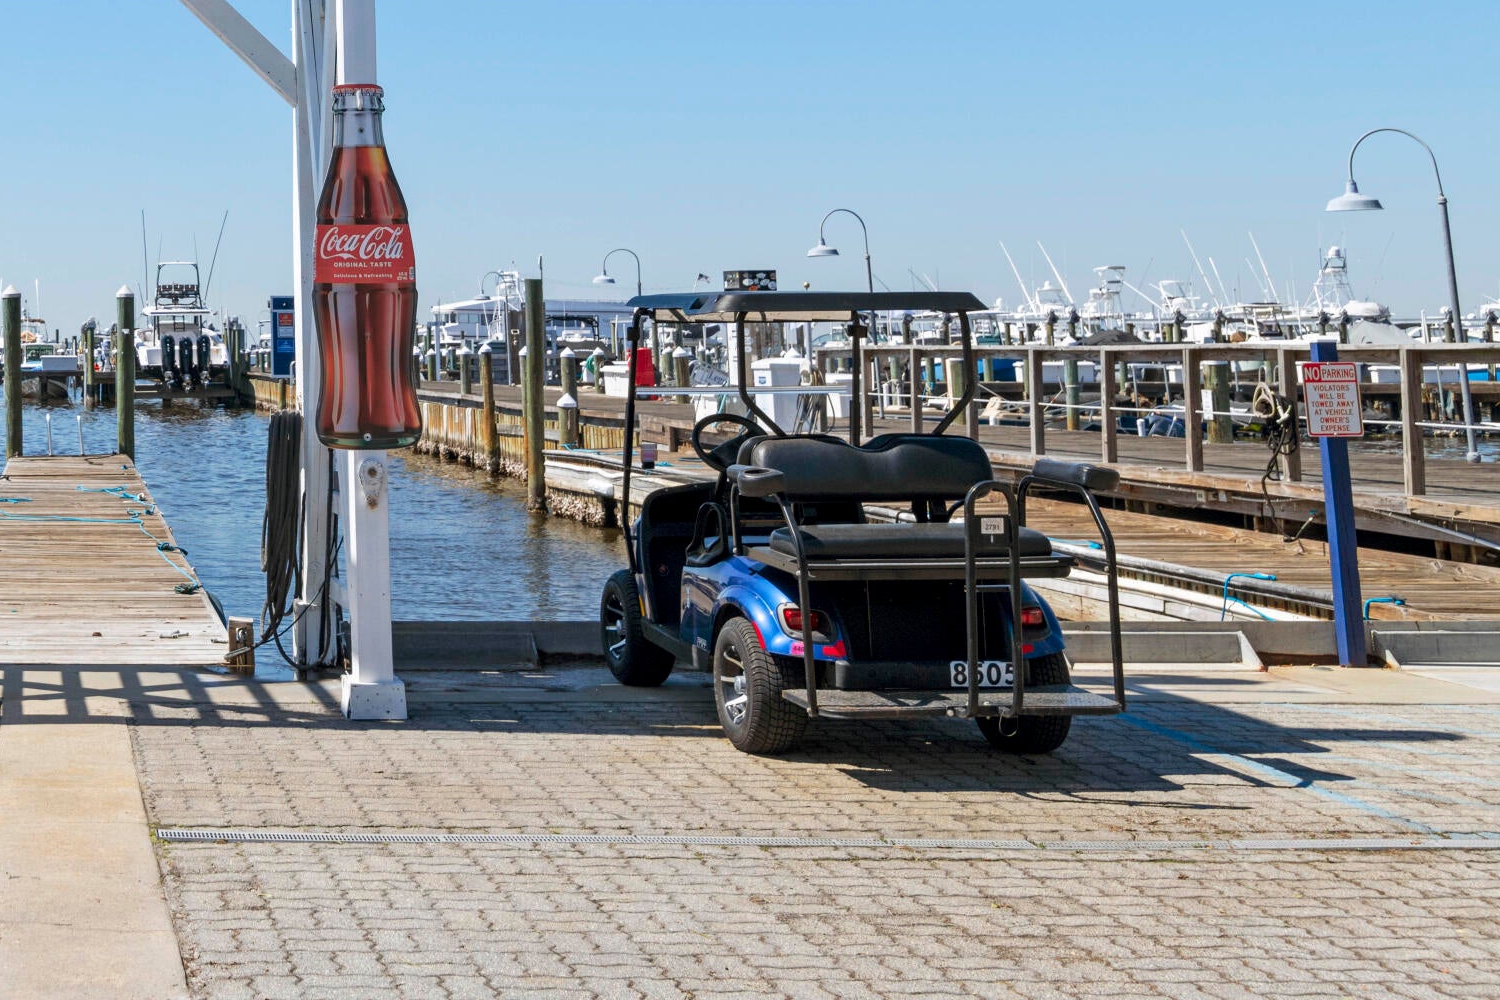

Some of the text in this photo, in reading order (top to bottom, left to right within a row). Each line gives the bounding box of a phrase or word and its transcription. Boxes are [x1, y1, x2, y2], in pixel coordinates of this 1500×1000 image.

[320, 226, 404, 260] Coca-Cola
[1304, 366, 1355, 380] NO PARKING
[1313, 384, 1350, 392] VIOLATORS
[1312, 400, 1334, 408] TOWED
[1314, 408, 1353, 416] AT VEHICLE
[1320, 424, 1351, 432] EXPENSE
